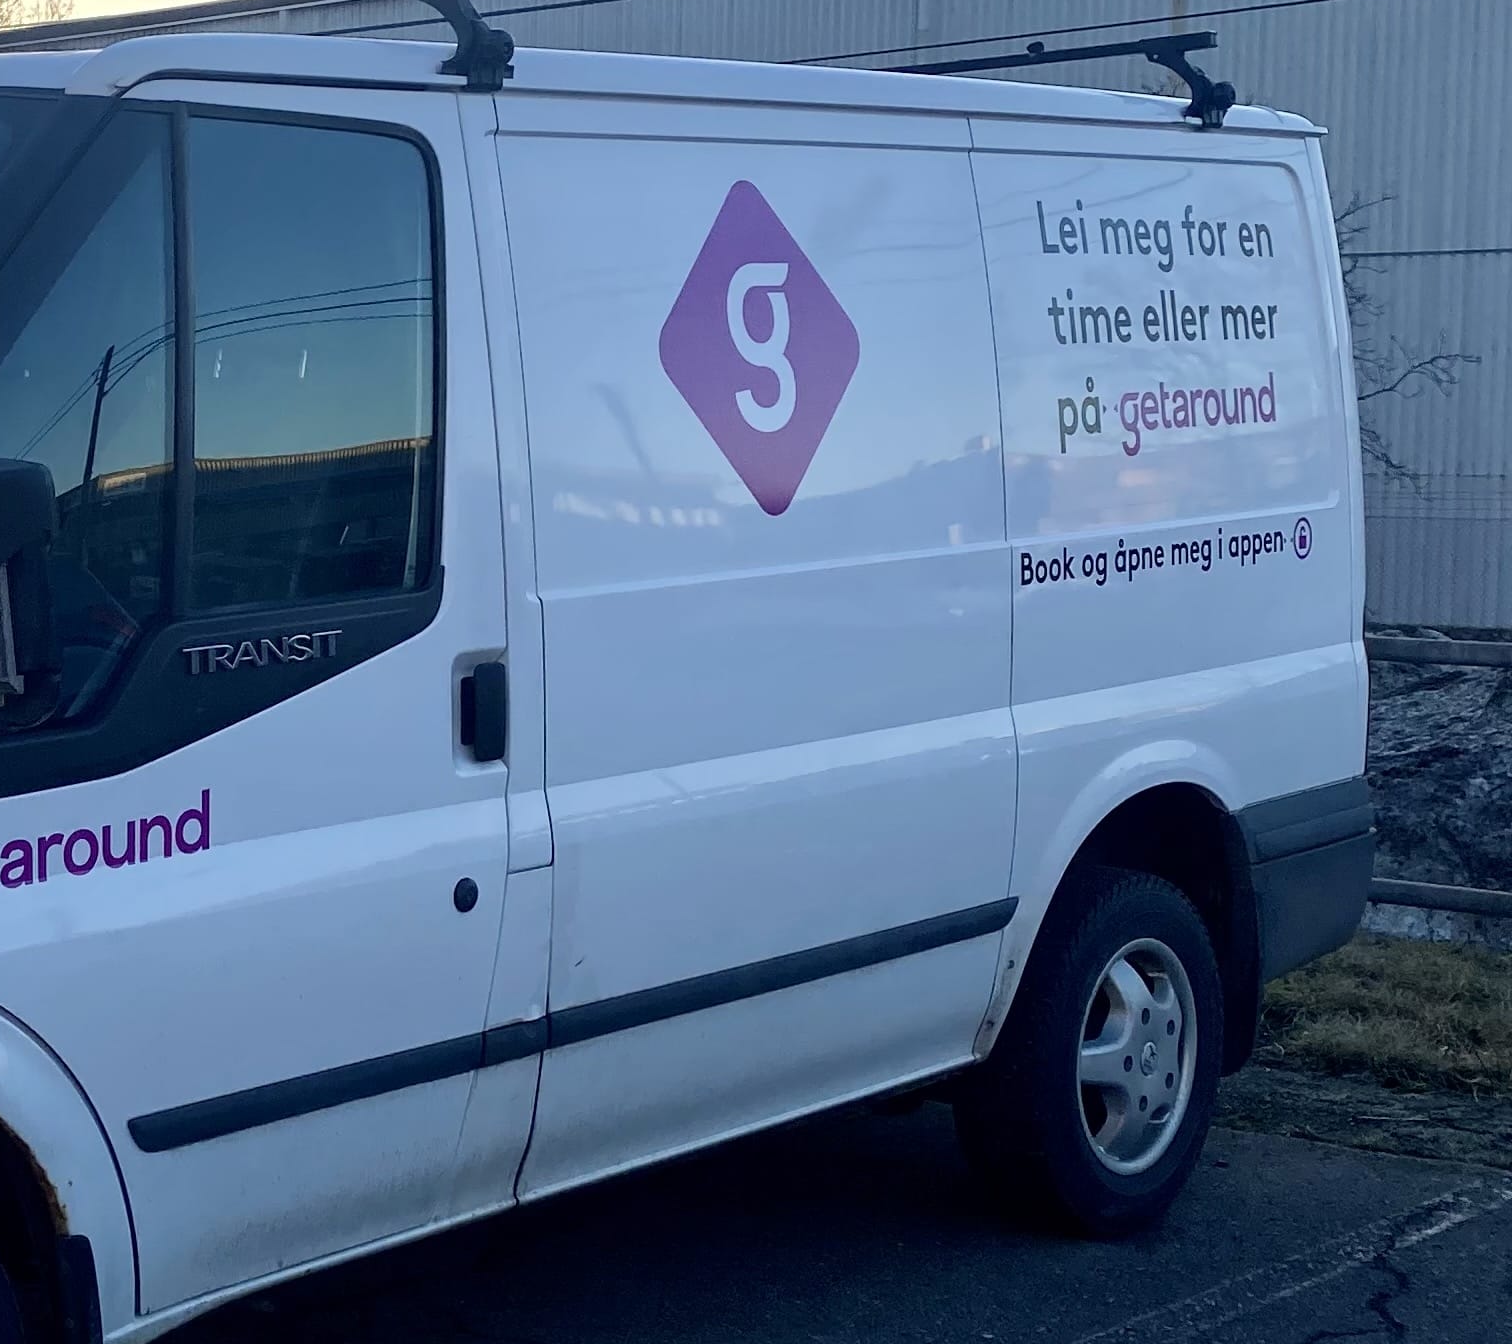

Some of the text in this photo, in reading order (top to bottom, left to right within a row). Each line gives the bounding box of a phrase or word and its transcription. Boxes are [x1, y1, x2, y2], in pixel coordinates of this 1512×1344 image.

[1036, 200, 1274, 272] Lei meg for en
[727, 262, 797, 433] g
[1047, 288, 1278, 345] time eller mer
[1058, 371, 1277, 457] på getaround
[1020, 528, 1284, 586] Book og åpne meg i appen
[183, 630, 343, 674] TRANSIT
